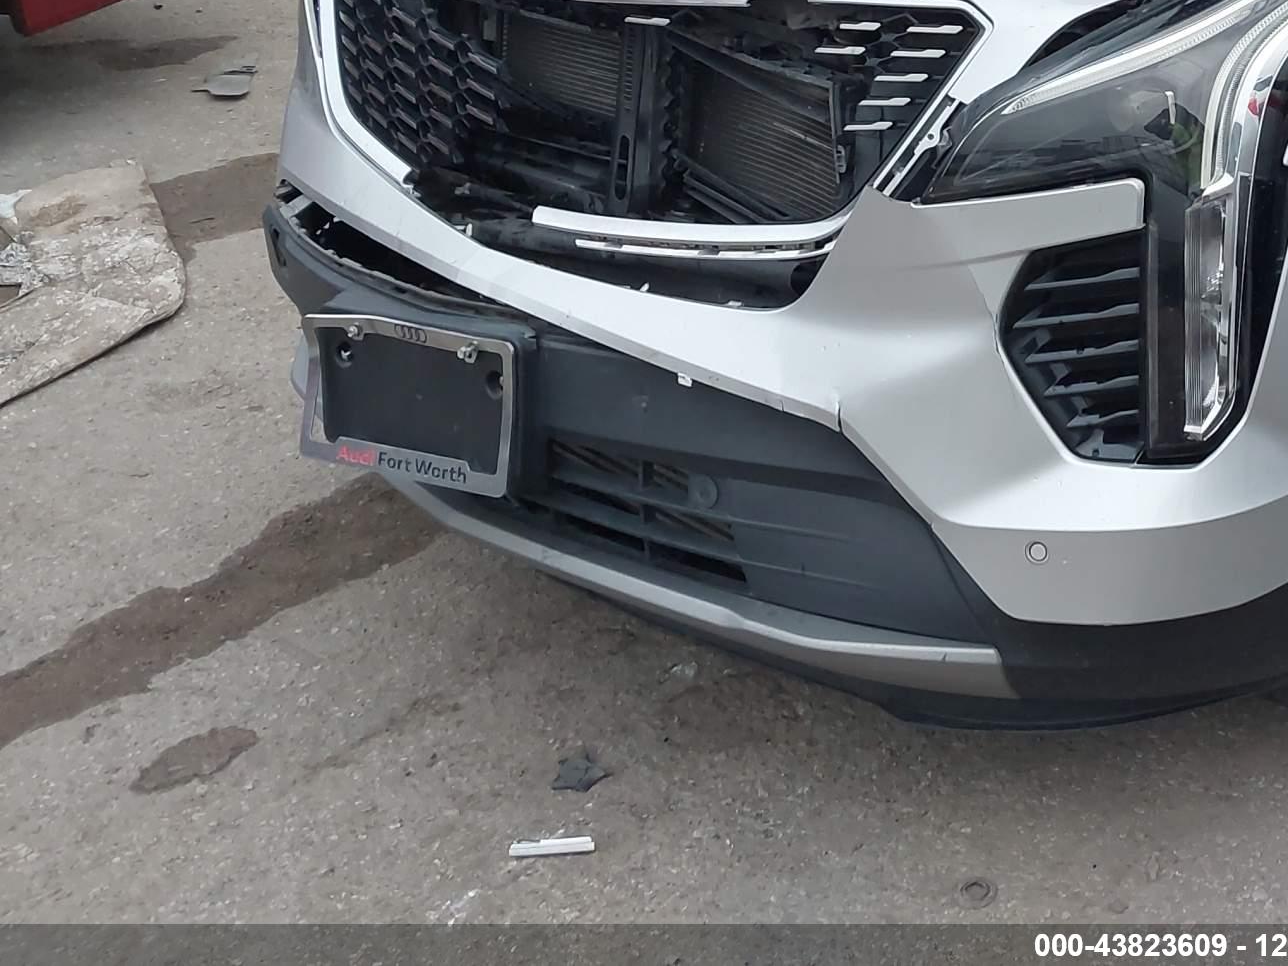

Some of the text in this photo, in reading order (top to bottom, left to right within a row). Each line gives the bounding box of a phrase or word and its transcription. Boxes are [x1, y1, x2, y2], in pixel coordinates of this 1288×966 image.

[336, 445, 467, 484] Audi Fort Worth
